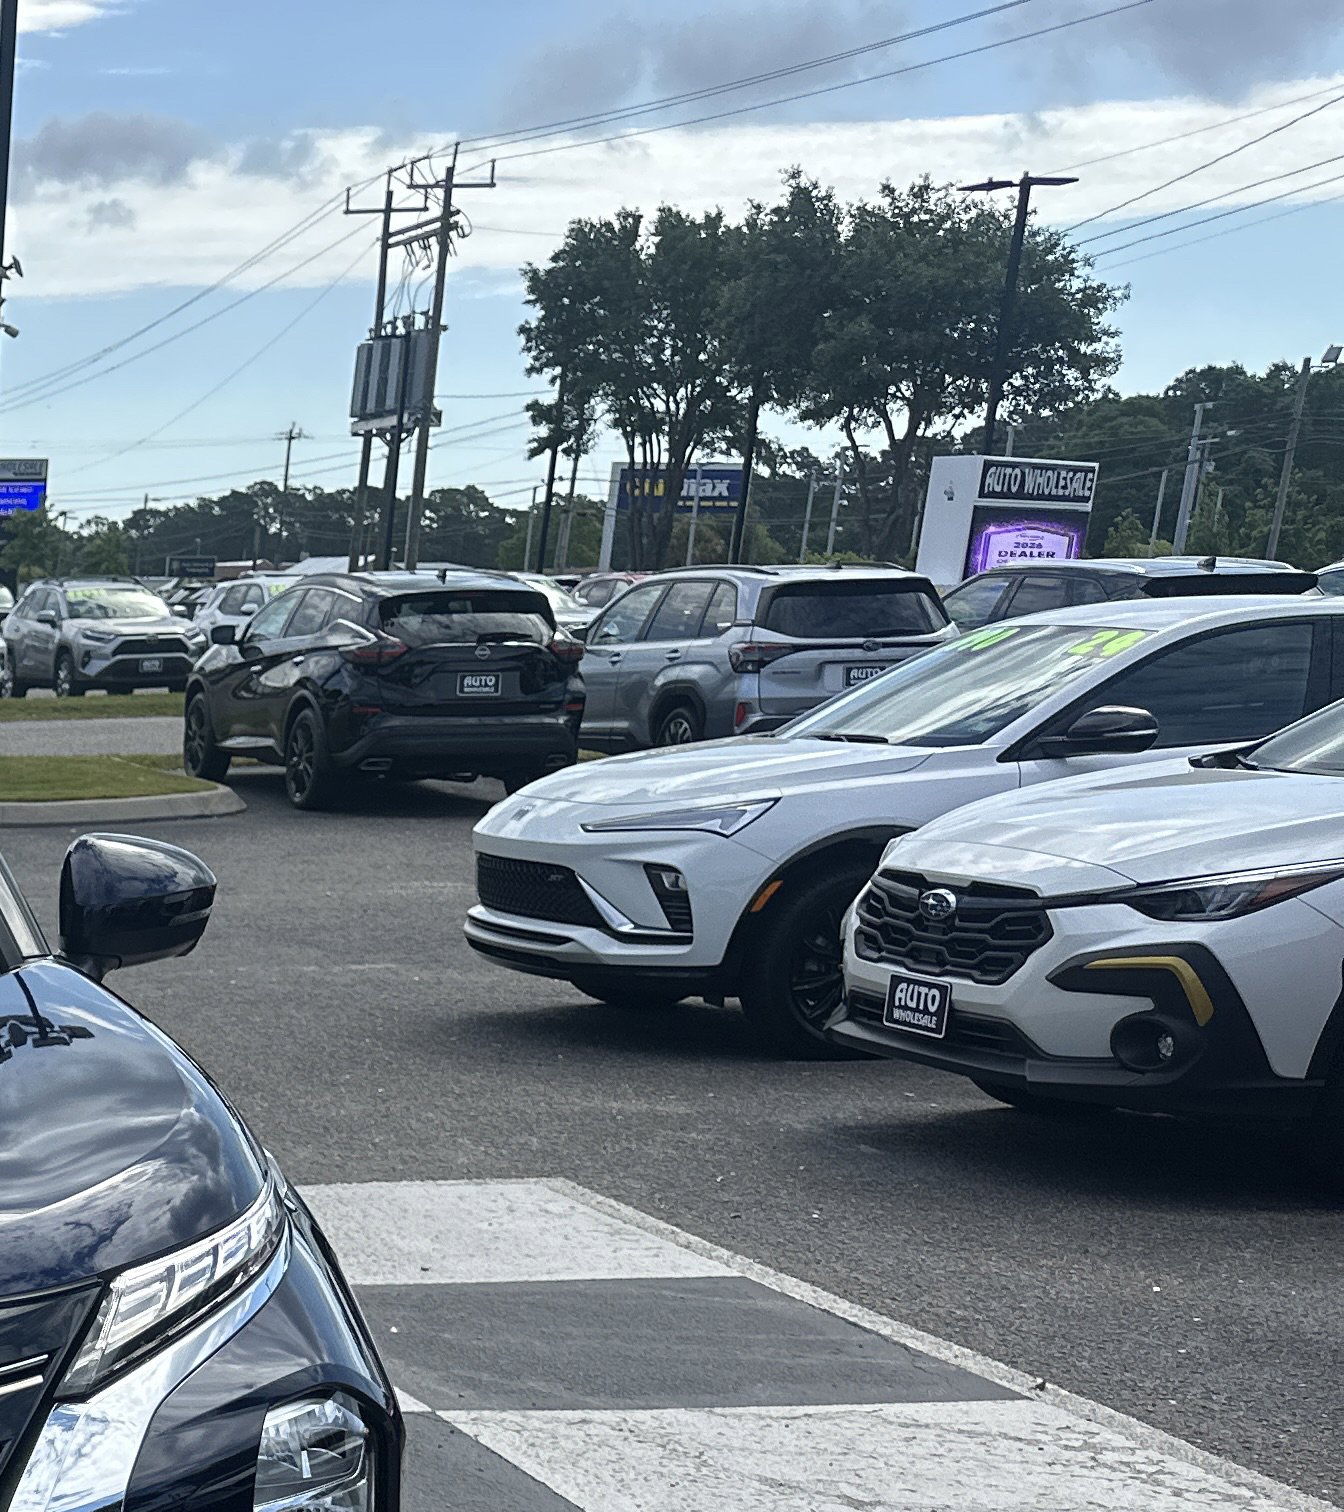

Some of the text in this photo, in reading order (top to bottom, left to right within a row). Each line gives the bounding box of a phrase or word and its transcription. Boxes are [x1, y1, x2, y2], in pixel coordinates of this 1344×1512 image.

[984, 466, 1094, 497] AUTO WHOLESALE
[997, 550, 1056, 558] DEALER
[463, 675, 496, 687] AUTO
[894, 982, 941, 1013] AUTO
[892, 1007, 937, 1028] WHOLESALE
